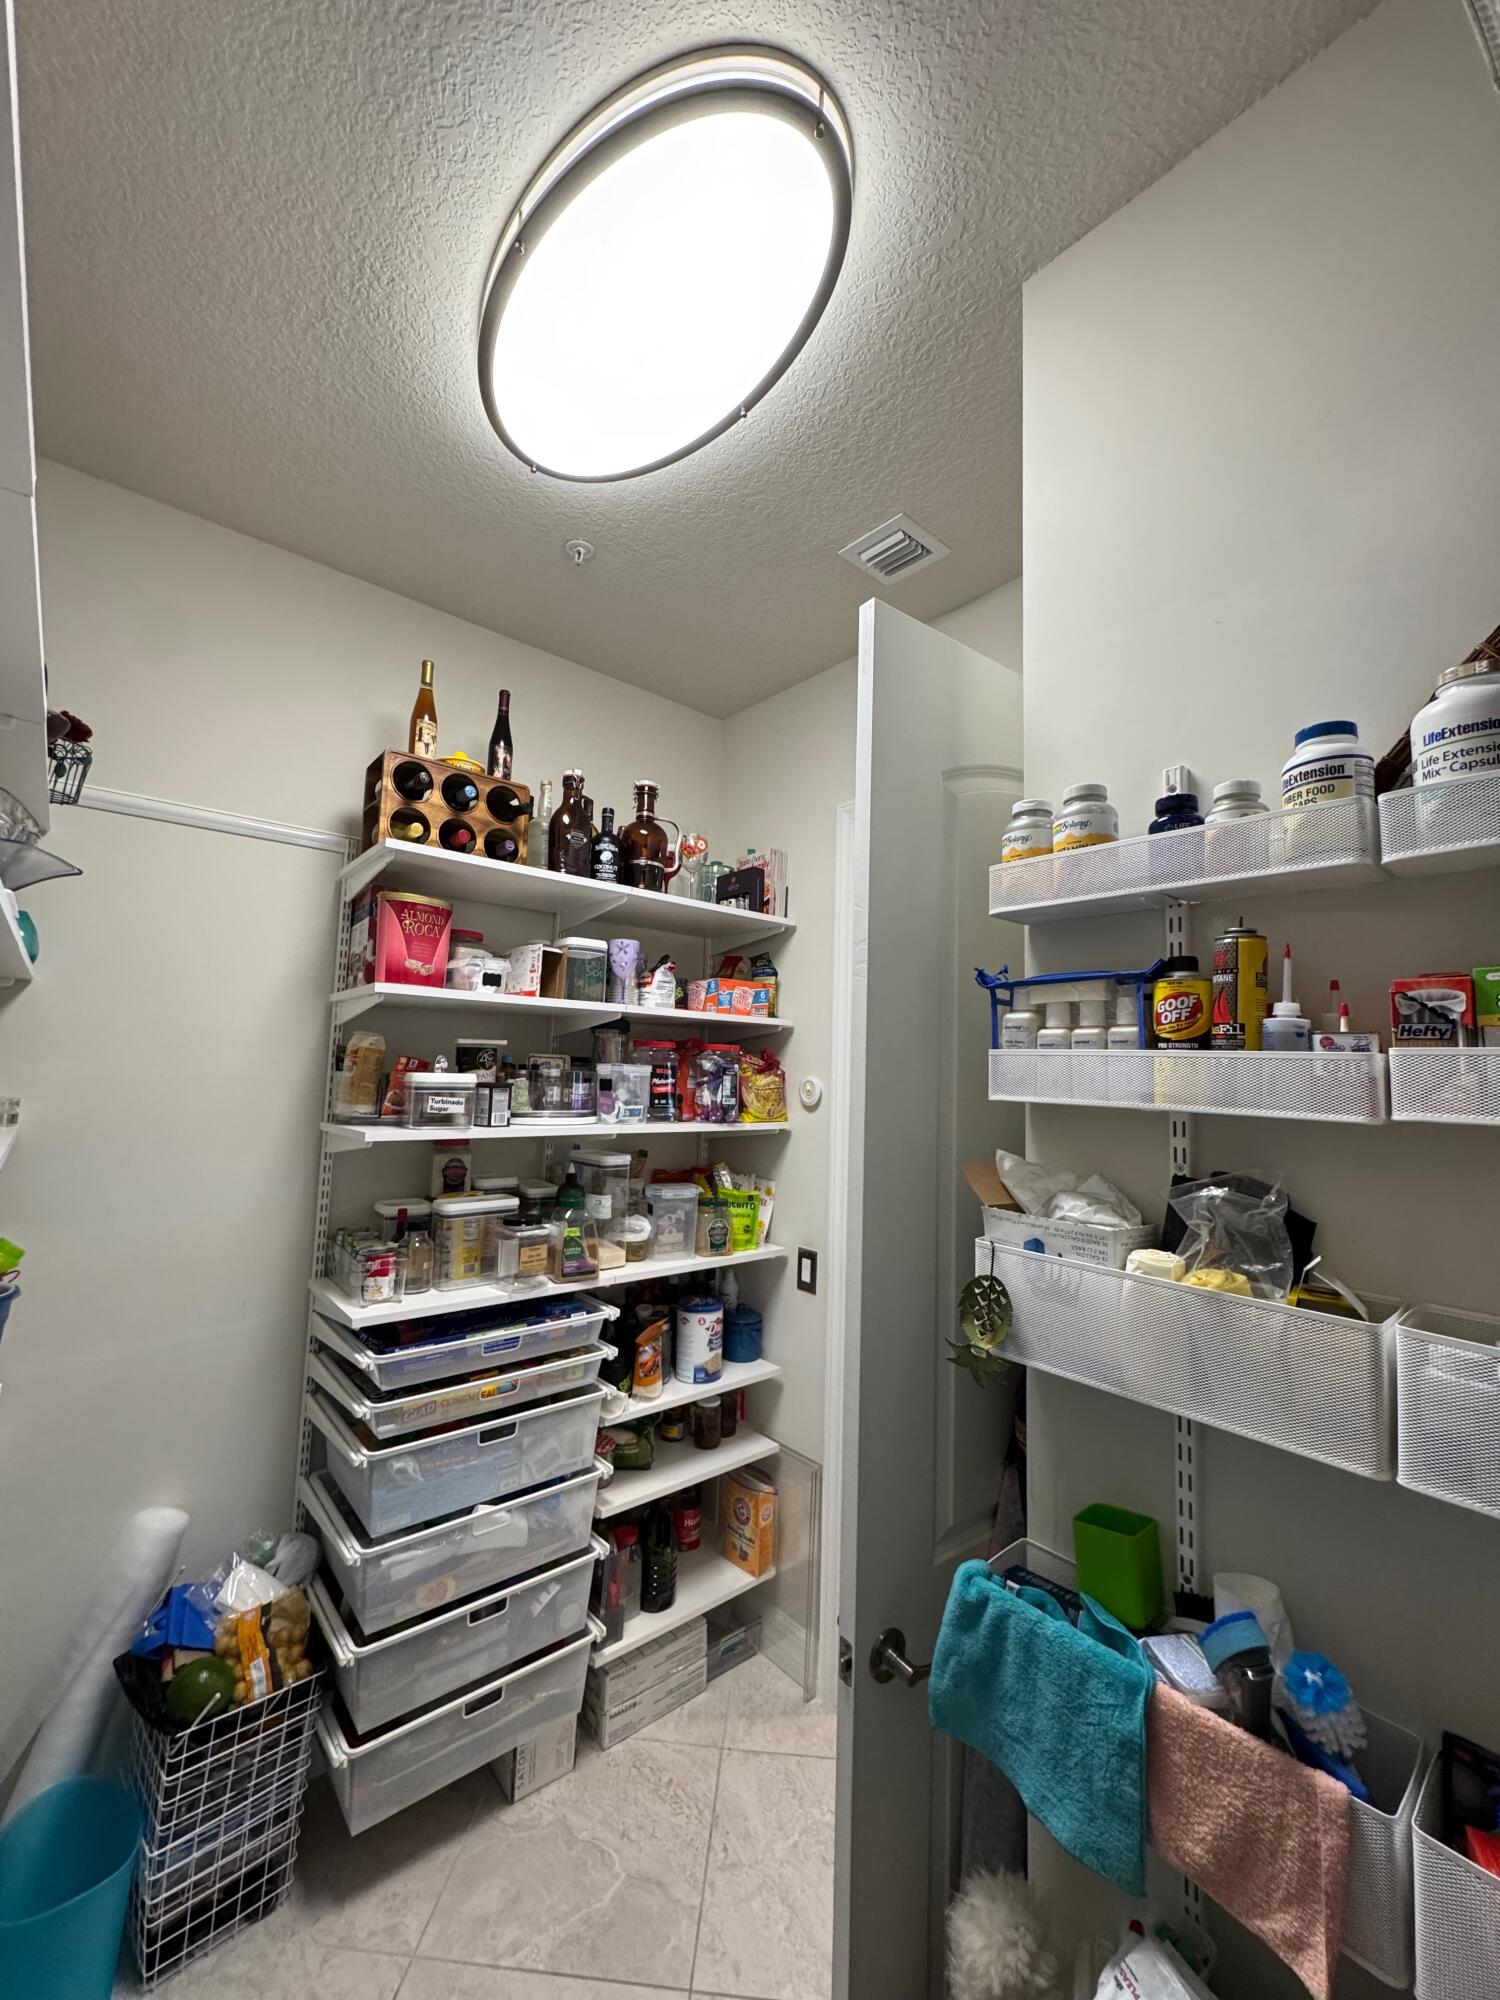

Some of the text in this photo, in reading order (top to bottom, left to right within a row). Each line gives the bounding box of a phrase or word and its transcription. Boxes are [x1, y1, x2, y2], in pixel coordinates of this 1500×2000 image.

[1423, 717, 1500, 747] LifeExtensio
[1421, 741, 1500, 770] Life Extensi
[1449, 755, 1500, 772] Capsul
[1306, 783, 1335, 797] FOOD
[401, 909, 444, 925] ALMOND
[402, 920, 440, 938] ROCA
[760, 991, 766, 999] 6
[1157, 994, 1199, 1013] GOOF
[1161, 1008, 1191, 1024] OFF
[1400, 1025, 1449, 1038] Hefty
[431, 1097, 464, 1106] Turbinado
[1119, 1967, 1141, 2000] PLEAS
